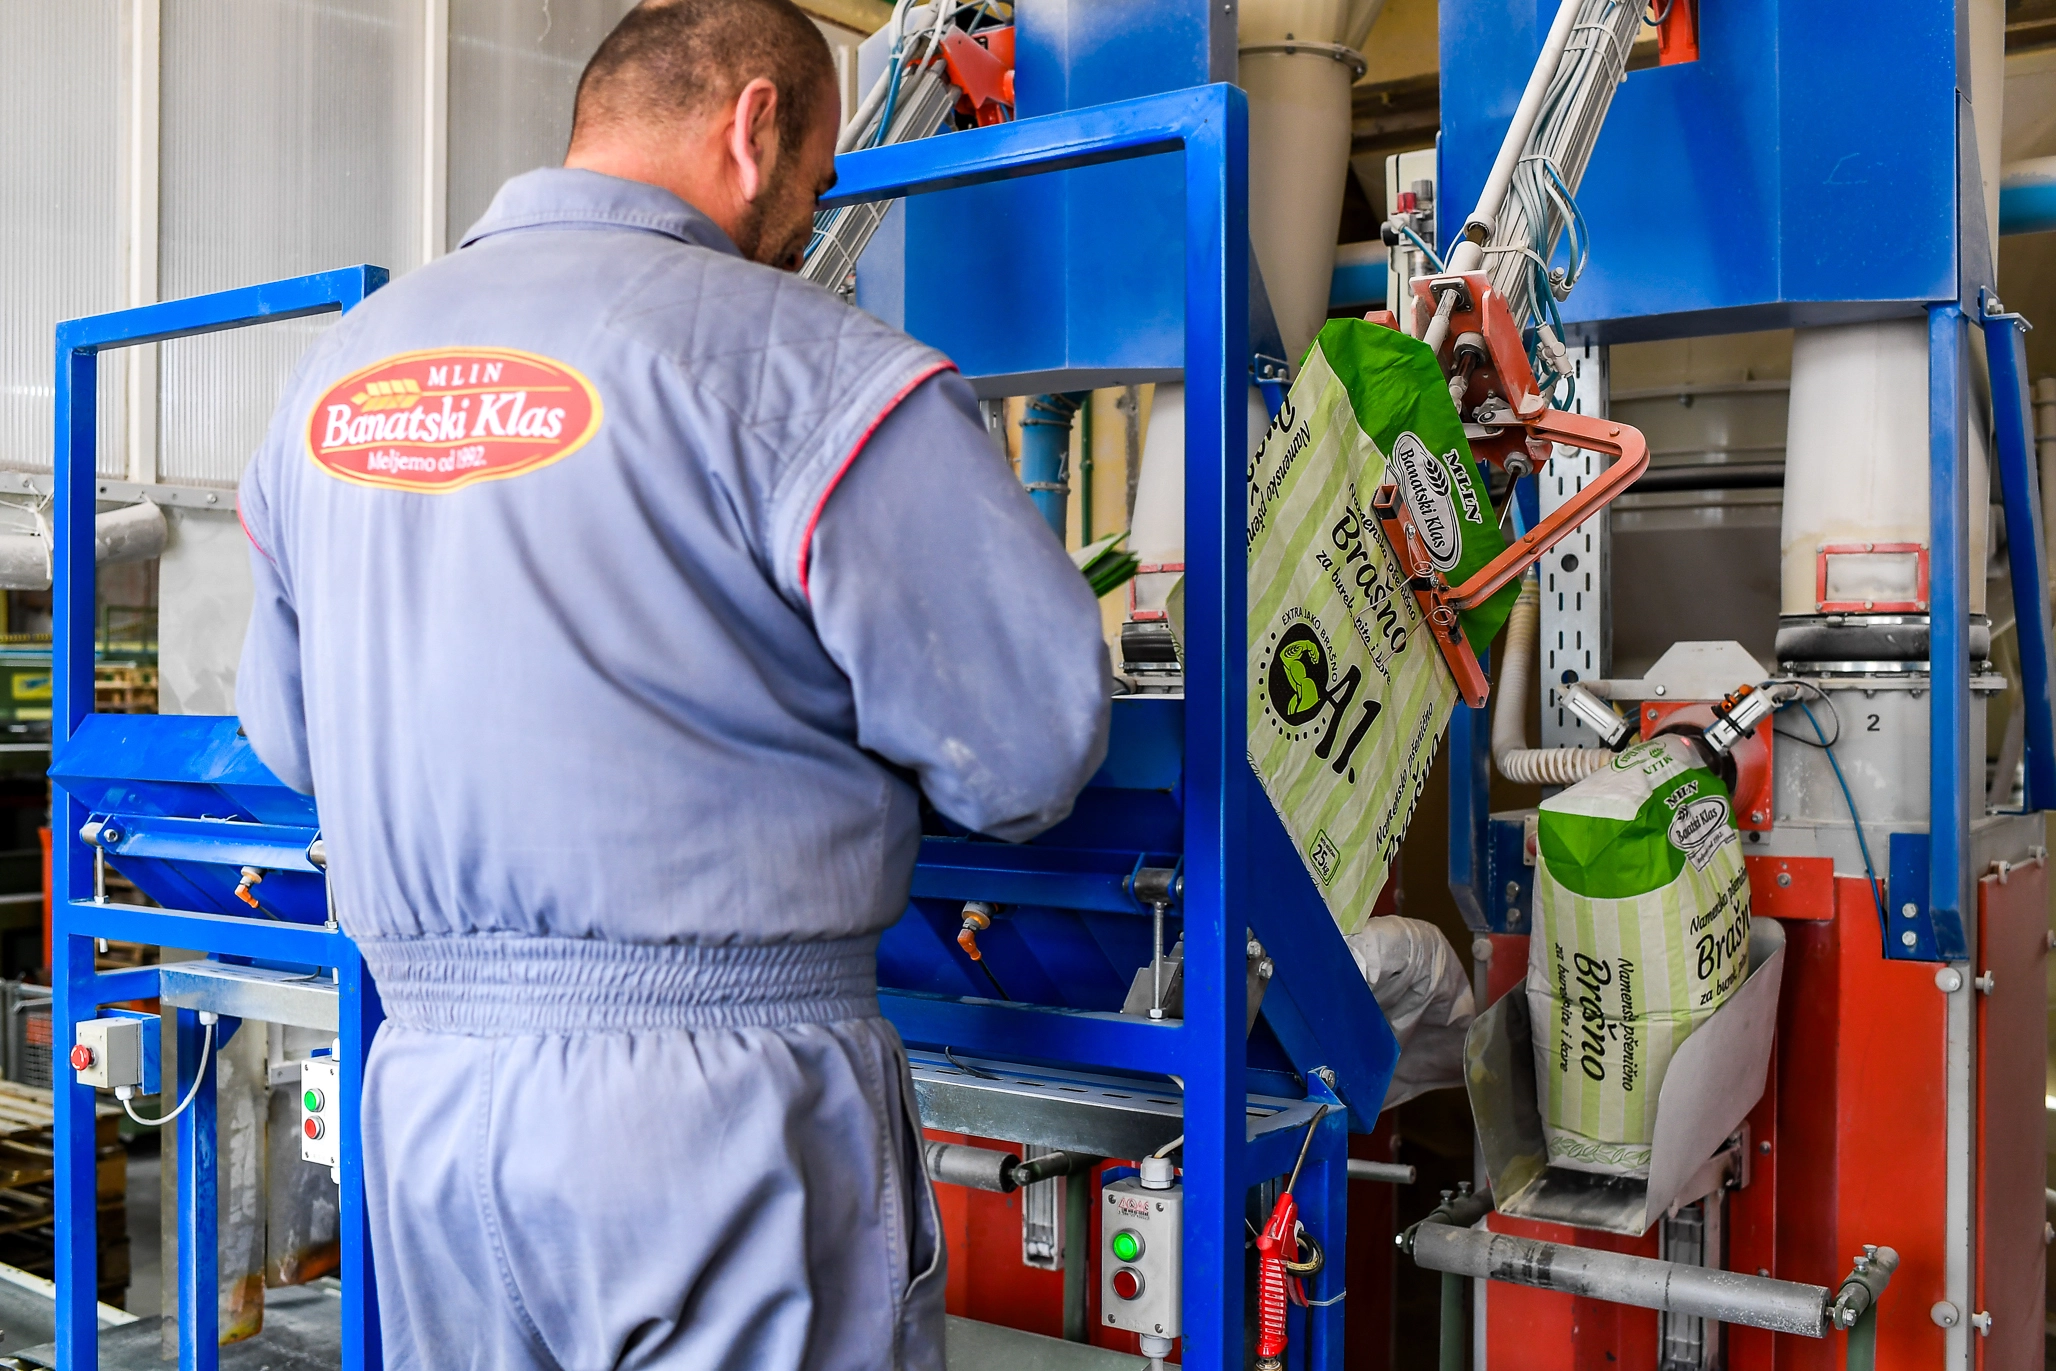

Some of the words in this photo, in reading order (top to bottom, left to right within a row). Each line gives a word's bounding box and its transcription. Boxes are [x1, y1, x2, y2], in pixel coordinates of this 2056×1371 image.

[427, 362, 503, 387] MLIN
[321, 395, 470, 448] Banatski
[470, 391, 566, 439] Klas
[367, 448, 437, 474] Meljemo
[437, 449, 456, 472] od
[1266, 420, 1311, 502] Namensko
[1444, 450, 1481, 523] MLIN
[1400, 447, 1437, 516] Banatski
[1424, 515, 1446, 549] Klas
[1315, 550, 1334, 571] za
[1331, 505, 1407, 654] Brašno
[1281, 607, 1303, 626] EXTRA
[1319, 629, 1338, 683] BRAŠNO
[1867, 714, 1880, 732] 2
[1554, 942, 1565, 962] za
[1695, 893, 1752, 981] Brašn
[1573, 952, 1618, 1082] Brašno
[1699, 988, 1713, 1006] za
[1559, 1039, 1573, 1073] kore
[1619, 1021, 1639, 1092] pšenično
